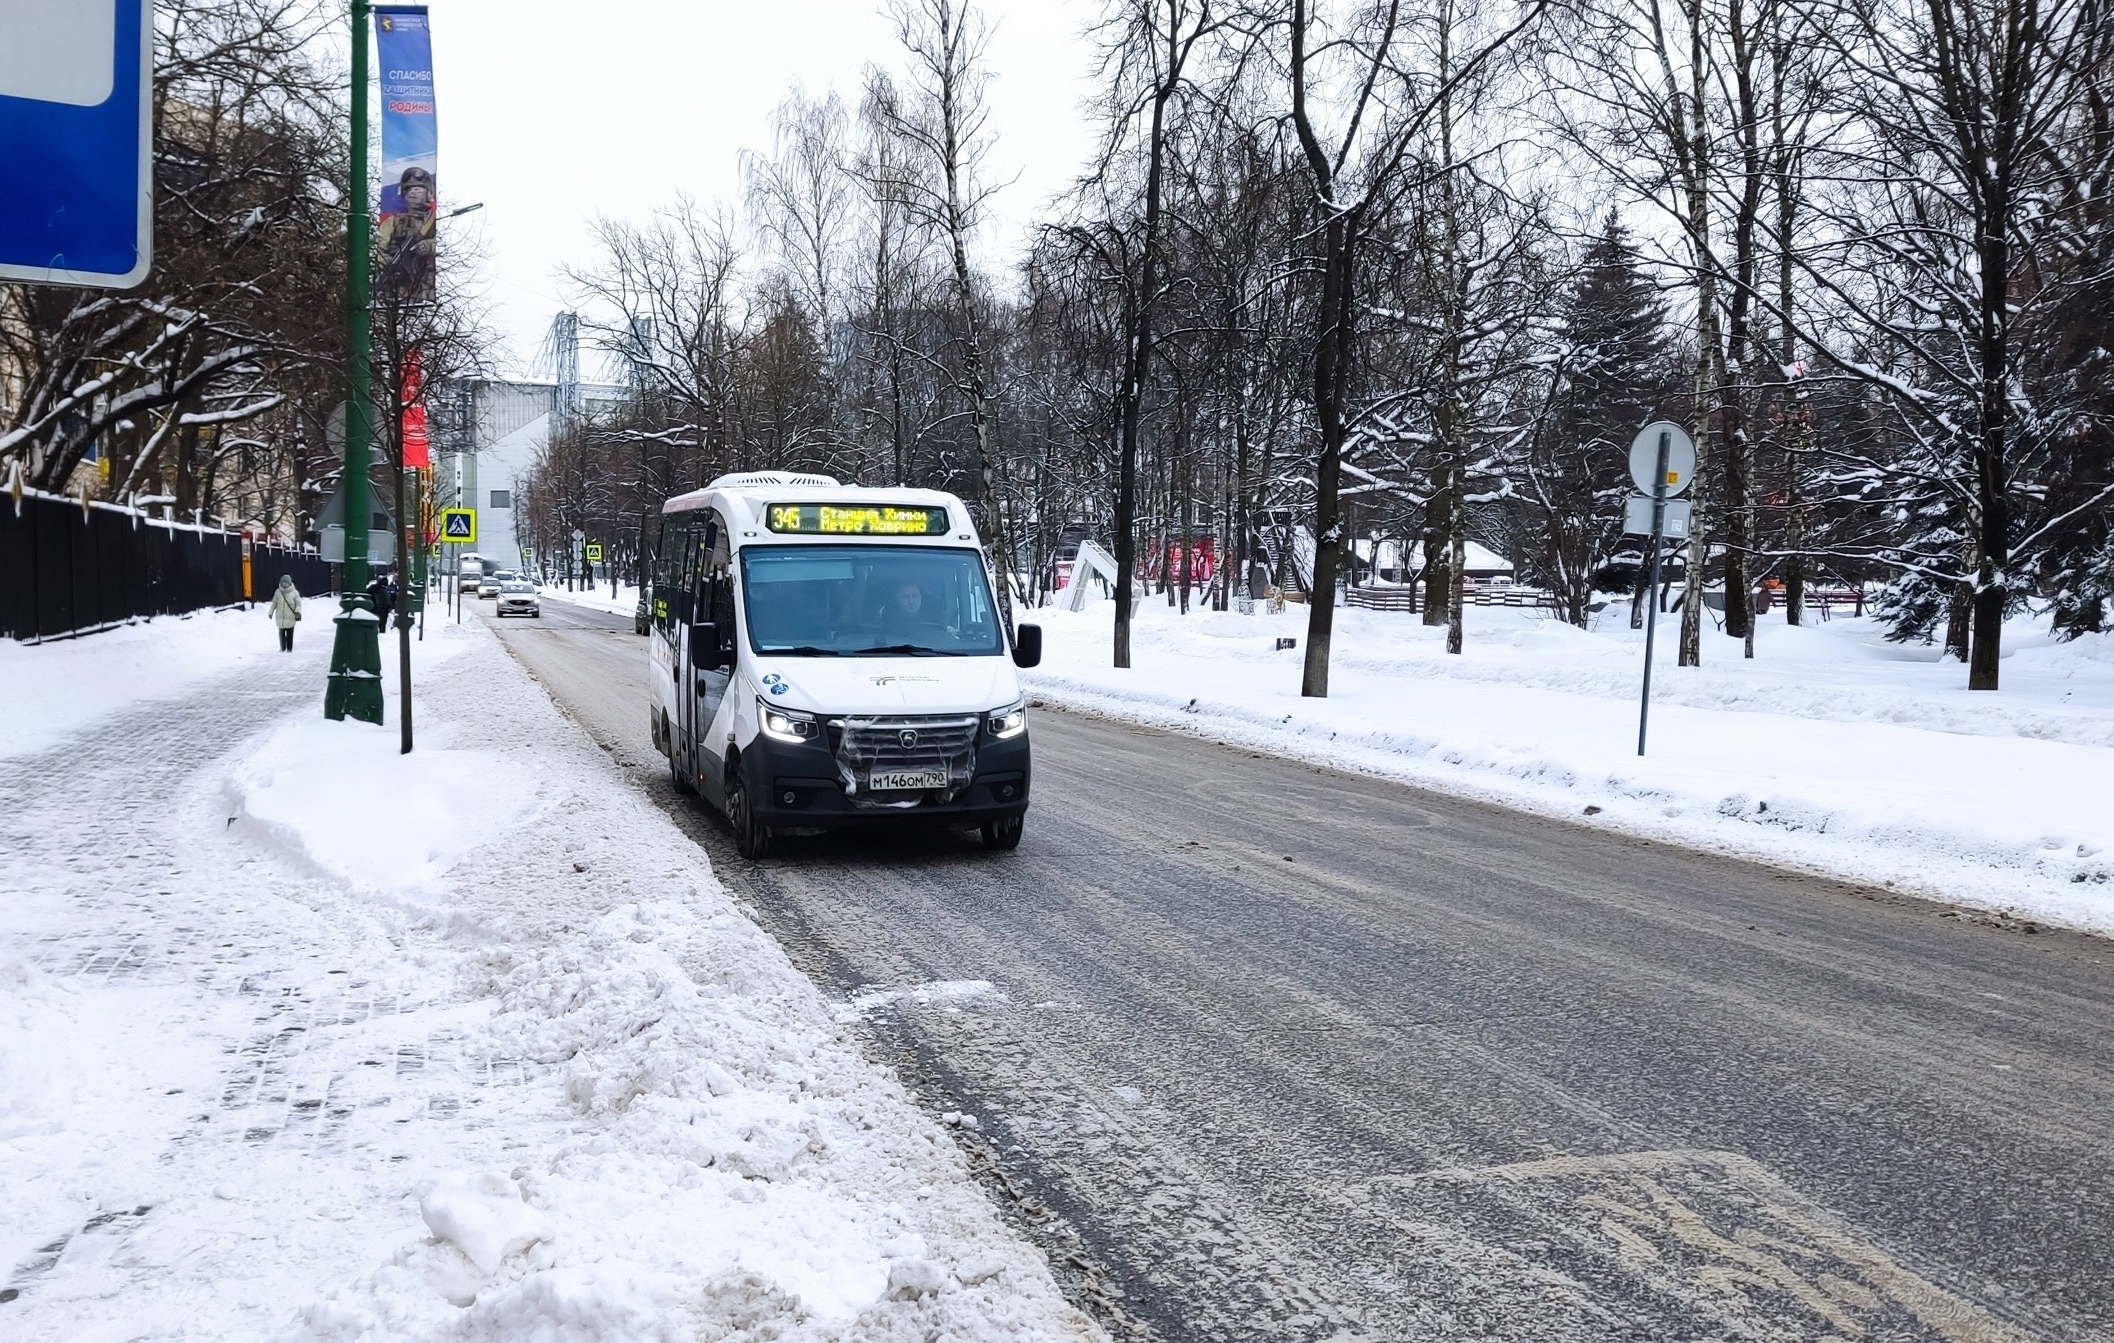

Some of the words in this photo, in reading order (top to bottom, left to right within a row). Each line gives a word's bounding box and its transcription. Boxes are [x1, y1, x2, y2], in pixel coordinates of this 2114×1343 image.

[388, 70, 432, 81] СПАСИБО
[773, 507, 800, 529] 345
[820, 507, 879, 520] Станция
[885, 508, 927, 521] Химки
[820, 519, 864, 533] Метро
[870, 520, 927, 534] Ховрино
[873, 774, 924, 788] М146ОМ
[925, 772, 945, 783] 790
